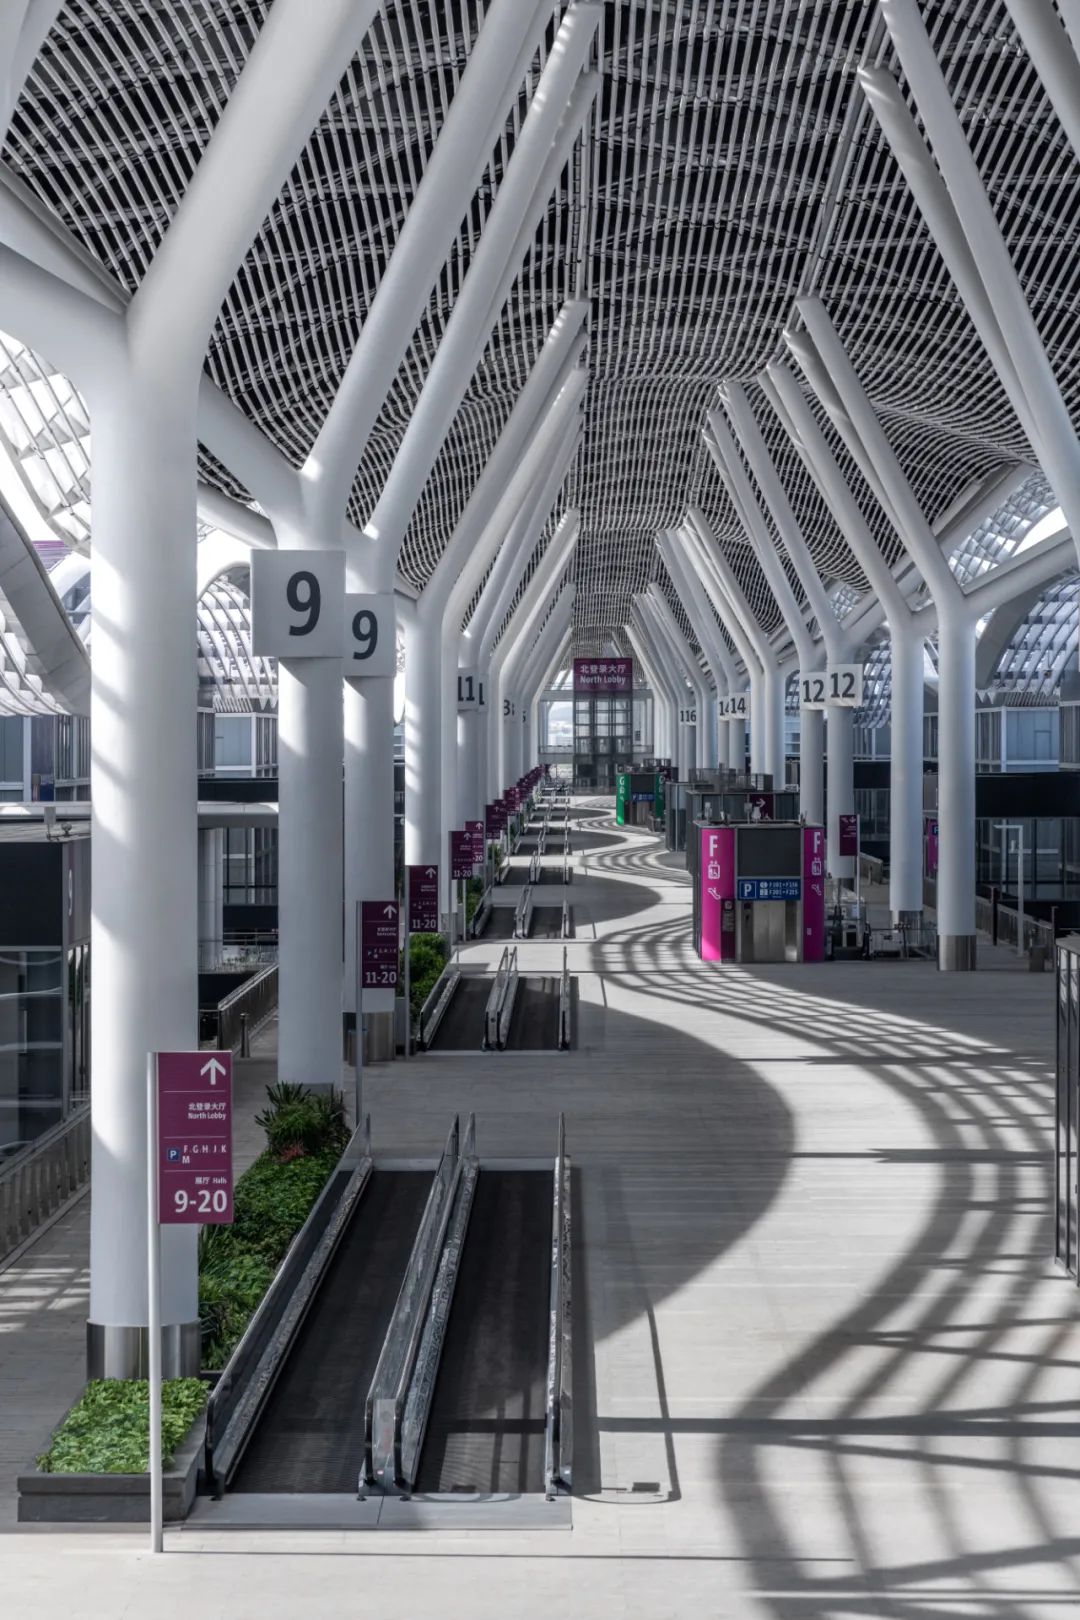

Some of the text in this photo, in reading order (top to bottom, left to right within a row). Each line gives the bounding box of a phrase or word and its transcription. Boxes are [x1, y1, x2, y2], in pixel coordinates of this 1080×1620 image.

[286, 570, 321, 636] 9
[351, 609, 378, 660] 9
[580, 675, 626, 686] North Lobby
[830, 672, 855, 698] 12
[802, 679, 825, 702] 12
[730, 697, 746, 714] 14
[709, 835, 718, 857] F
[814, 831, 821, 854] F
[453, 869, 472, 878] 11-20
[744, 883, 752, 897] P
[411, 918, 437, 929] 11-20
[365, 971, 397, 984] 11-20
[188, 1112, 227, 1121] North Lobby
[170, 1150, 177, 1160] P
[182, 1155, 191, 1164] M
[174, 1189, 227, 1213] 9-20
